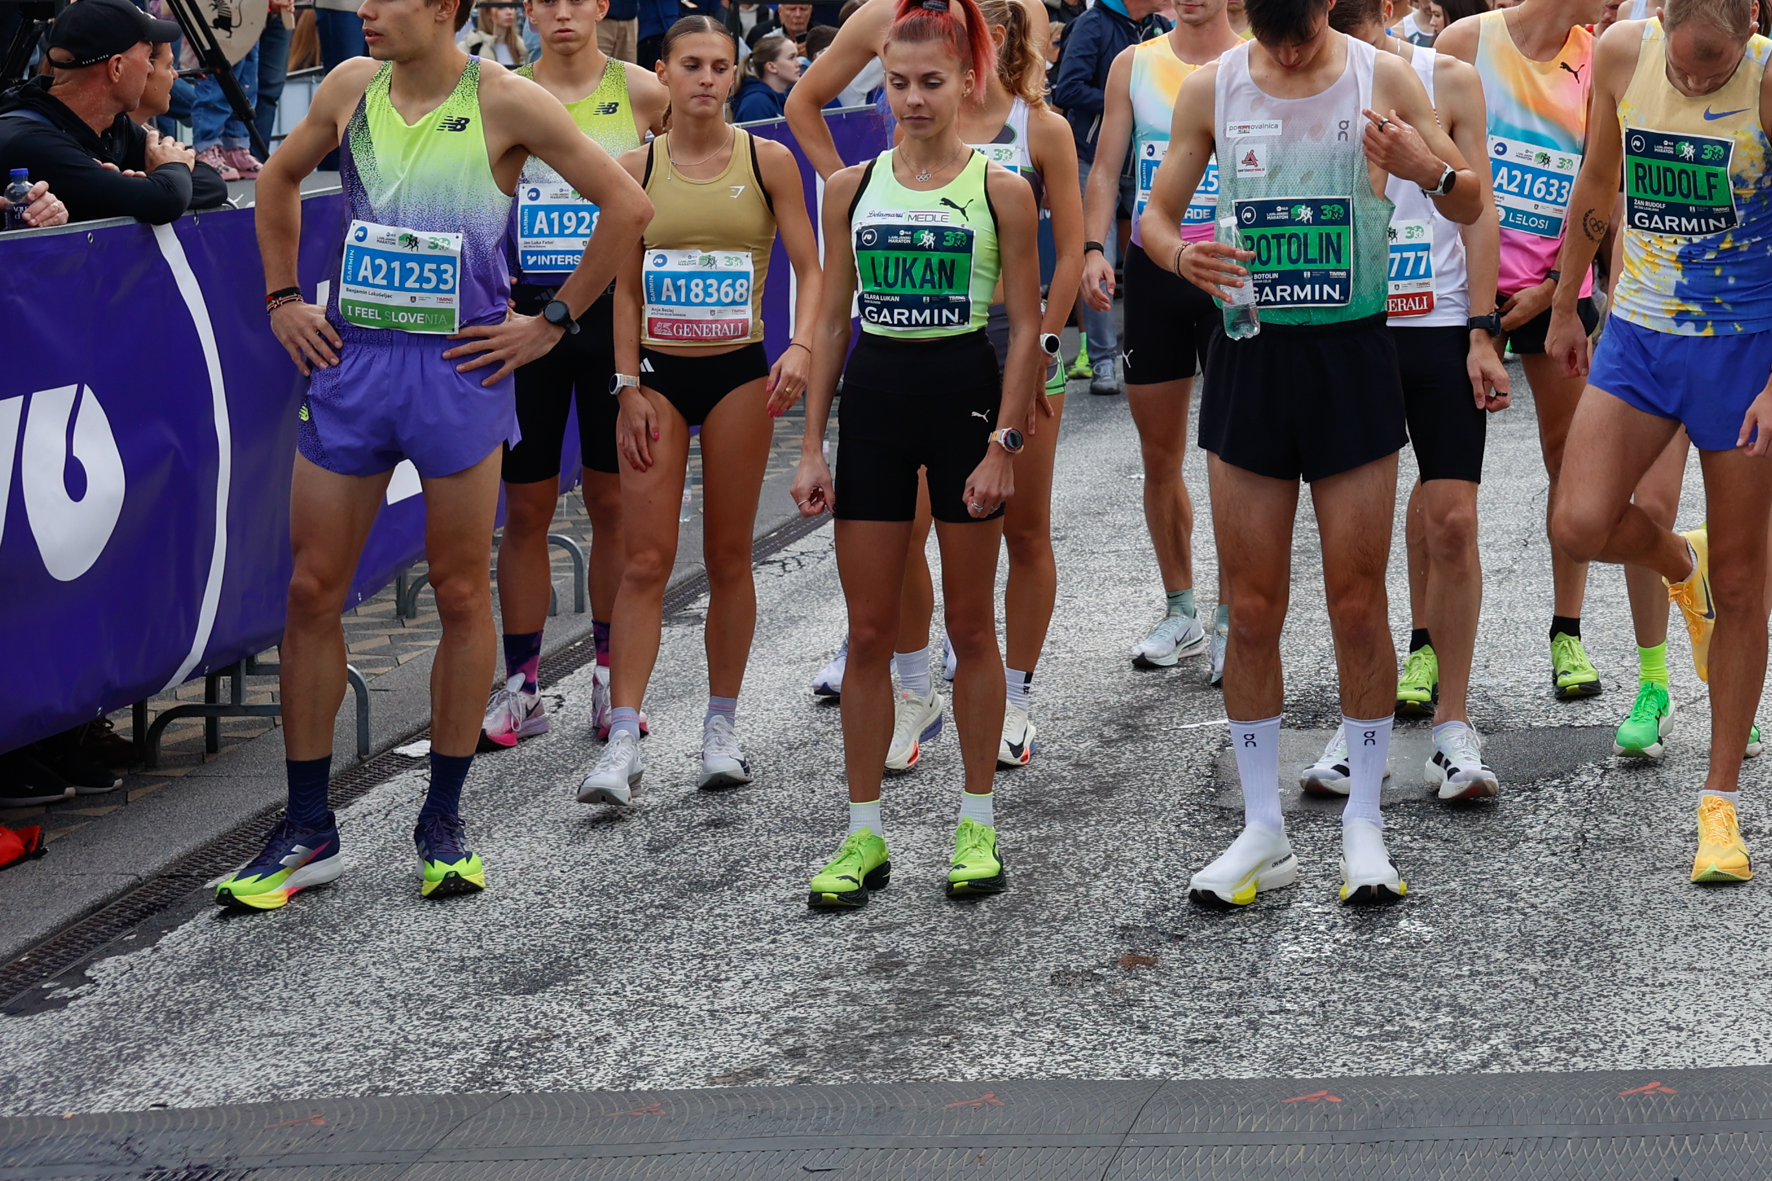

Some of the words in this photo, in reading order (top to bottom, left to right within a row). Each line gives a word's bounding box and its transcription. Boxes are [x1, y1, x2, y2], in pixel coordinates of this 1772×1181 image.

[1493, 167, 1570, 203] A21633
[1635, 162, 1719, 201] RUDOLF
[1645, 201, 1666, 209] RUDOLF
[908, 214, 949, 223] MEDLE
[1509, 212, 1549, 229] LELOSI
[1634, 212, 1726, 232] GARMIN
[358, 255, 454, 290] A21253
[871, 257, 955, 289] LUKAN
[661, 278, 748, 303] A18368
[864, 293, 880, 301] KLARA
[348, 305, 352, 315] I
[355, 307, 381, 319] FEEL
[385, 311, 447, 324] SLOVENIA
[864, 307, 959, 324] GARMIN
[674, 323, 743, 337] GENERALI
